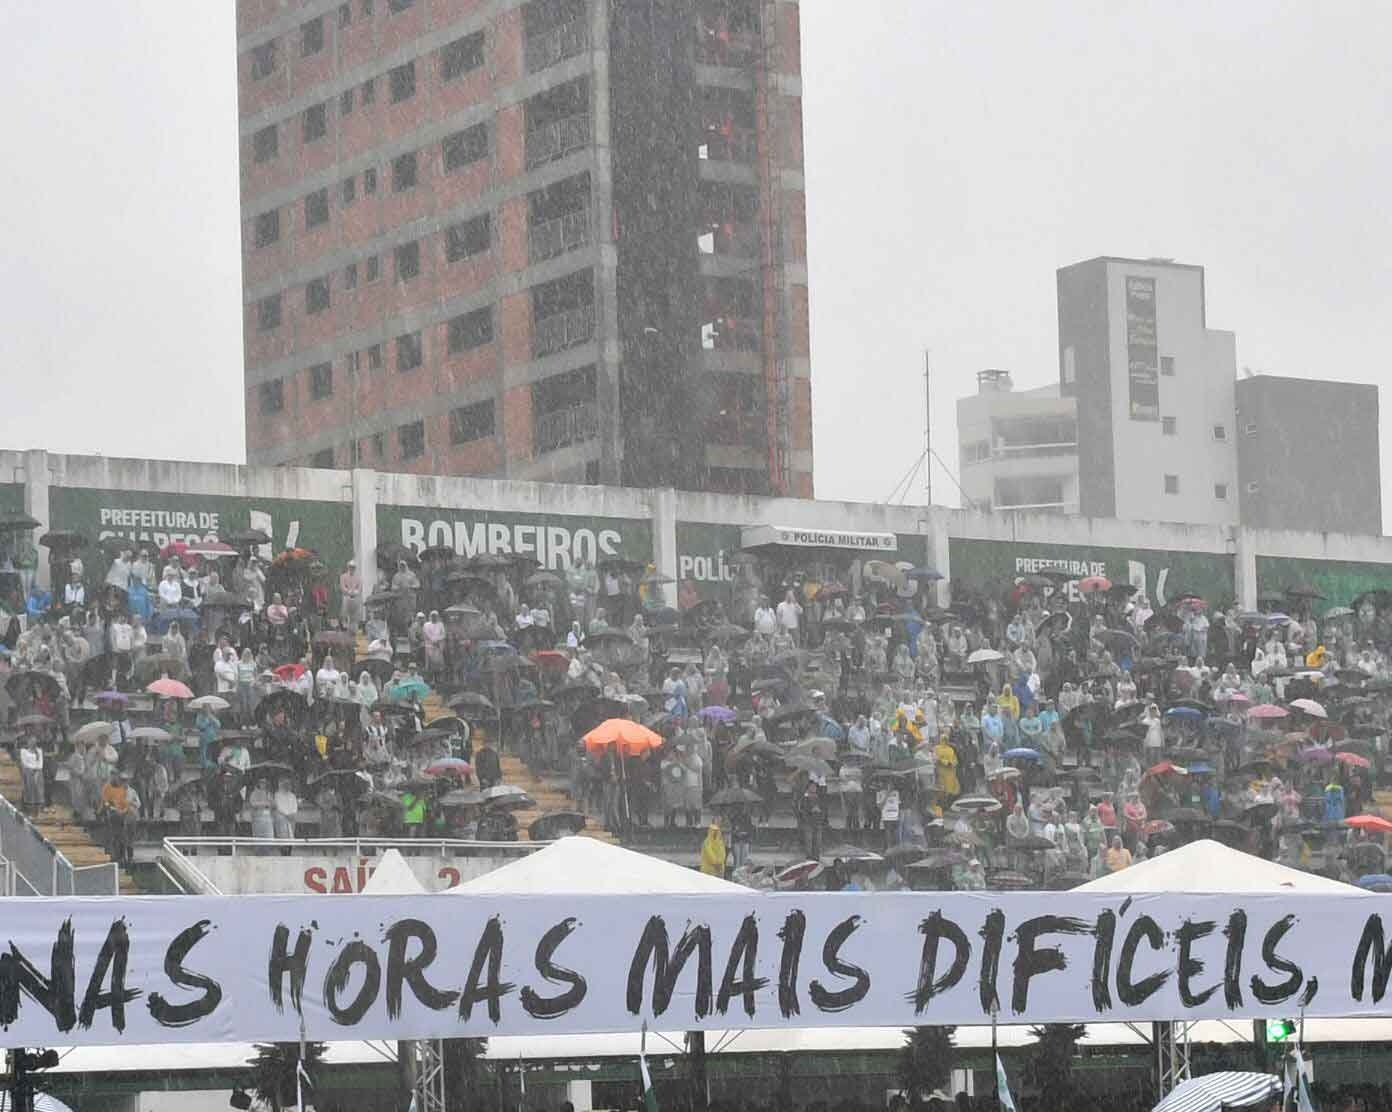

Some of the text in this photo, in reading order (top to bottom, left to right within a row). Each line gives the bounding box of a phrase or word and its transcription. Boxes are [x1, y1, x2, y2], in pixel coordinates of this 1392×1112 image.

[100, 508, 219, 529] PREFEITURA DE
[401, 518, 622, 570] BOMBEIROS
[793, 532, 879, 547] POLÍCIA MILITAR
[1090, 562, 1106, 577] DE
[304, 855, 376, 894] SAÍ
[268, 917, 587, 1025] HORAS
[626, 908, 870, 1020] MAIS
[905, 897, 1318, 1015] DIFÍCEIS,
